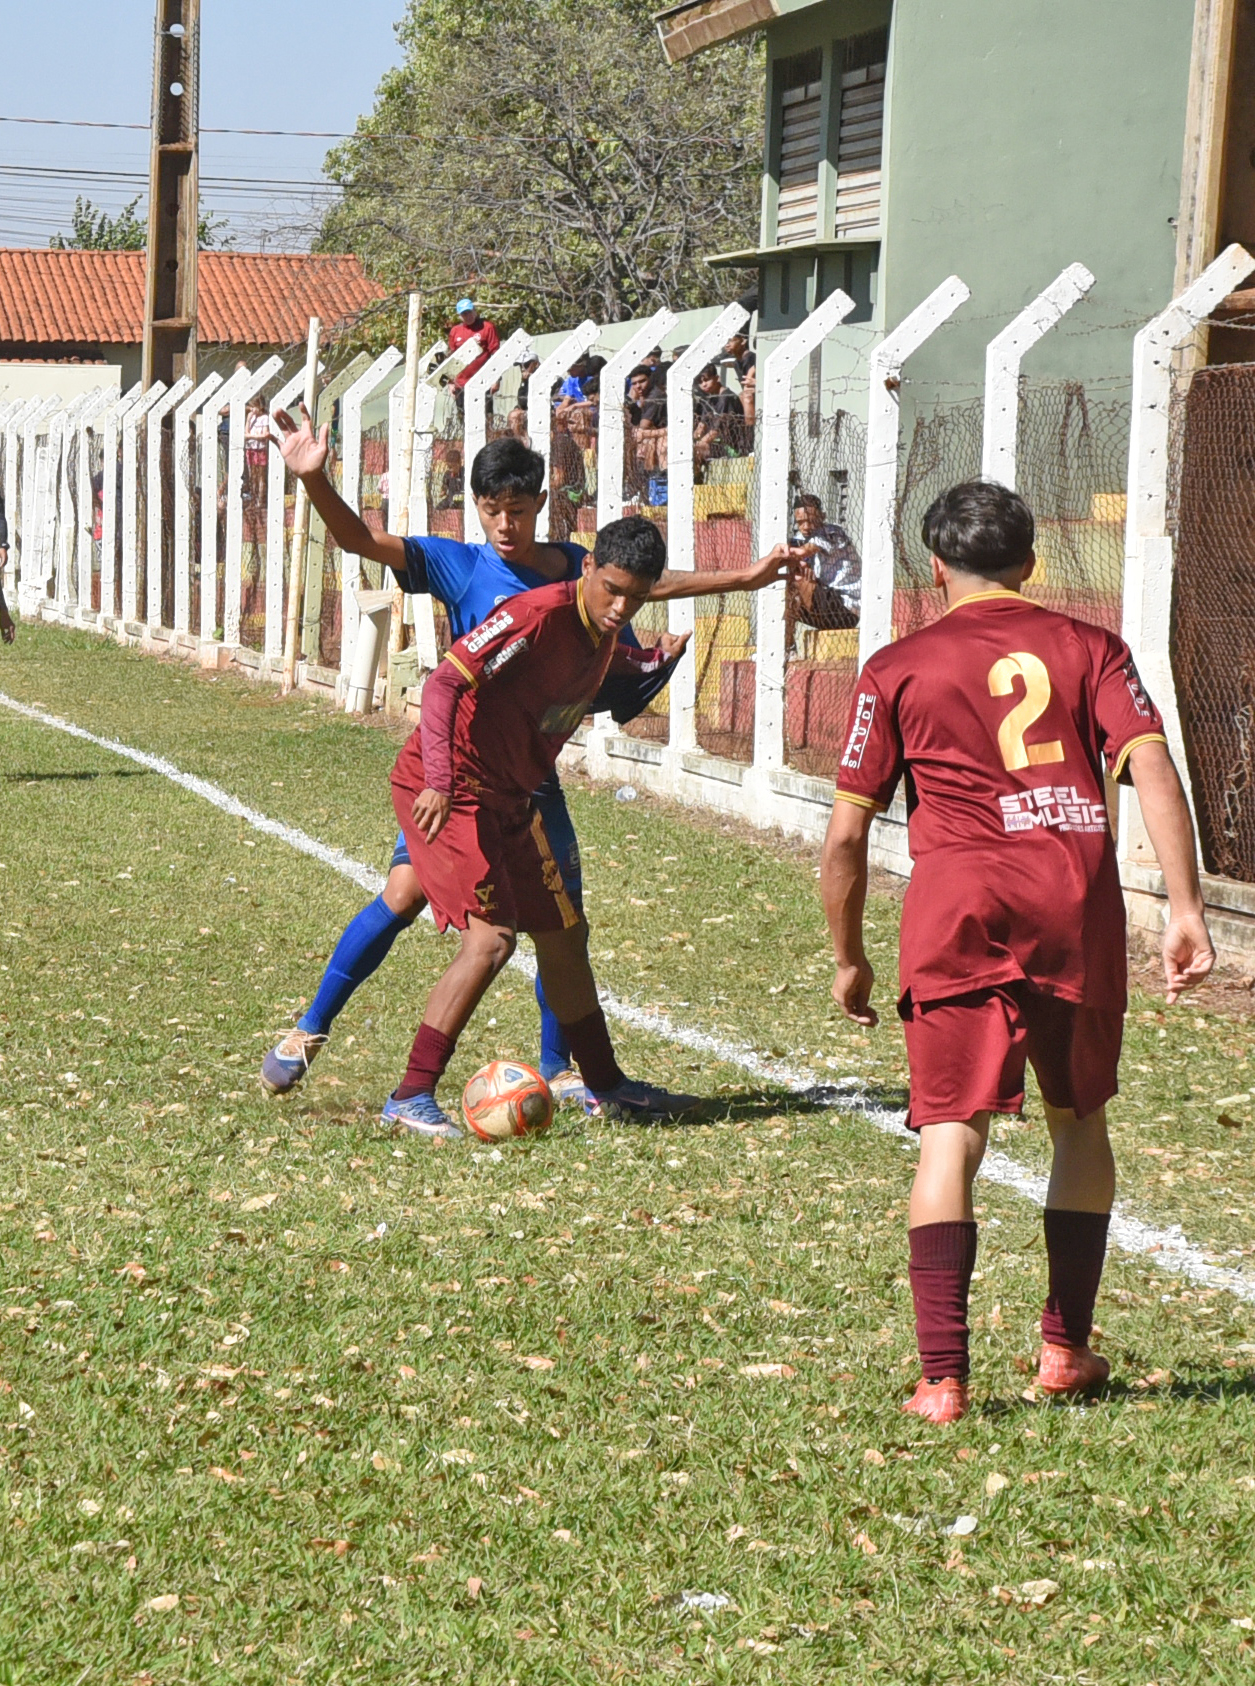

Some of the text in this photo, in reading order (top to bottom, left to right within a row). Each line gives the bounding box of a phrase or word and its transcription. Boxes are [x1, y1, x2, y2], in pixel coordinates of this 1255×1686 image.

[467, 614, 514, 653] SERMED
[988, 651, 1065, 772] 2
[848, 694, 874, 769] SAUDE
[999, 785, 1090, 813] STEEL
[1028, 804, 1107, 828] MUSIC
